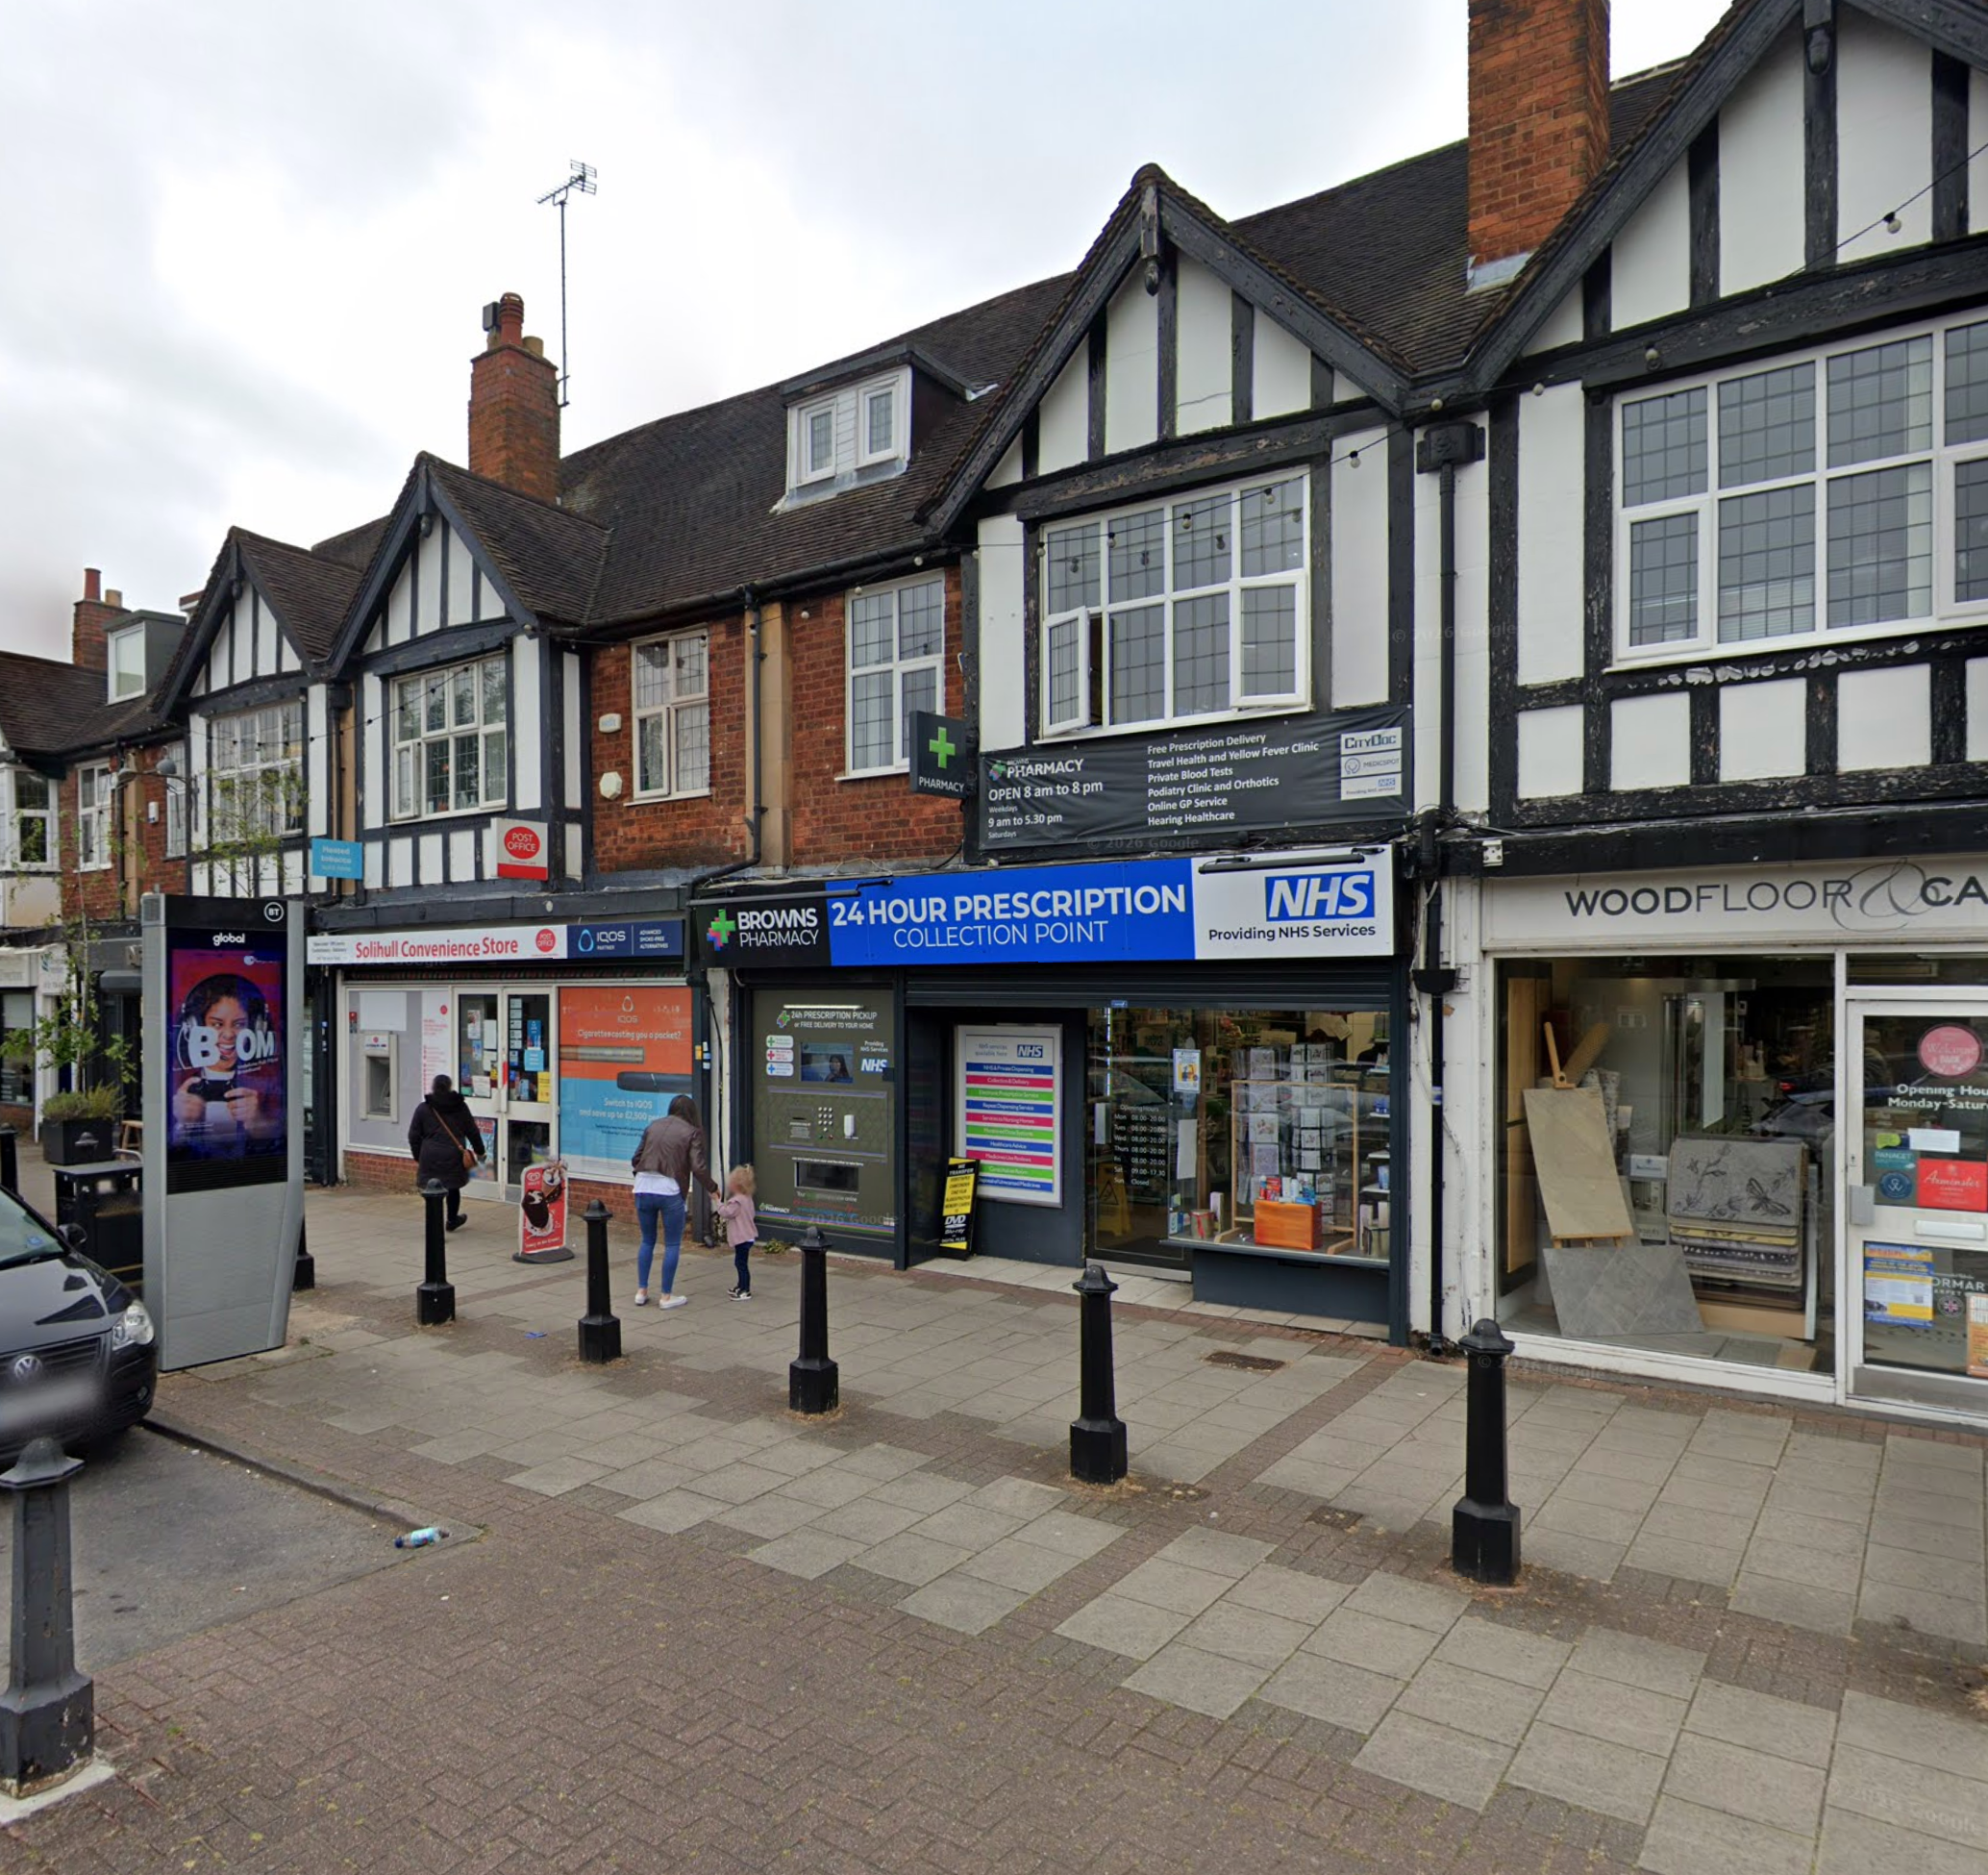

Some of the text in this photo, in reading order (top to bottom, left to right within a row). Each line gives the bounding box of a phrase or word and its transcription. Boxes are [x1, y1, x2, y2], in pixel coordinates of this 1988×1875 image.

[1148, 734, 1266, 755] Free Prescription Delivery
[1148, 741, 1319, 768] Travel Health and Yellow Fever Clinic
[1006, 759, 1084, 779] PHARMACY
[1363, 758, 1400, 767] MEDICSPOT
[1148, 766, 1233, 783] Private Blood Tests
[918, 777, 965, 792] PHARMACY
[1148, 776, 1280, 797] Podiatry Clinic and Orthotics
[1379, 778, 1395, 787] NHS
[988, 782, 1103, 801] OPEN 8 am to 8 pm
[988, 805, 1018, 813] Weekdays
[1148, 796, 1228, 812] Online GP Service
[988, 814, 1062, 828] 9 am to 5.30 pm
[1148, 812, 1235, 827] Hearing Healthcare
[511, 833, 534, 843] POST
[988, 831, 1017, 839] Saturdays
[508, 841, 536, 853] OFFICE
[1269, 874, 1371, 917] NHS
[1565, 879, 1852, 916] WOODFLOOR
[268, 908, 280, 916] BT
[832, 884, 1186, 927] 24 HOUR PRESCRIPTION
[737, 908, 818, 931] BROWNS
[212, 933, 245, 946] global
[597, 931, 626, 943] IQOS
[739, 928, 819, 948] PHARMACY
[893, 920, 1108, 948] COLLECTION POINT
[1208, 923, 1376, 942] Providing NHS Services
[356, 939, 398, 958] Solihull
[402, 938, 480, 957] Convenience
[483, 937, 518, 955] Store
[804, 1011, 852, 1020] PRESCRIPTION
[853, 1012, 878, 1020] PICKUP
[578, 1030, 611, 1039] Cigarettes
[611, 1031, 634, 1040] costing
[655, 1031, 682, 1040] packet?
[1017, 1045, 1042, 1058] NHS
[861, 1059, 888, 1072] NHS
[1897, 1084, 1955, 1098] Opening
[945, 1215, 966, 1225] DVD
